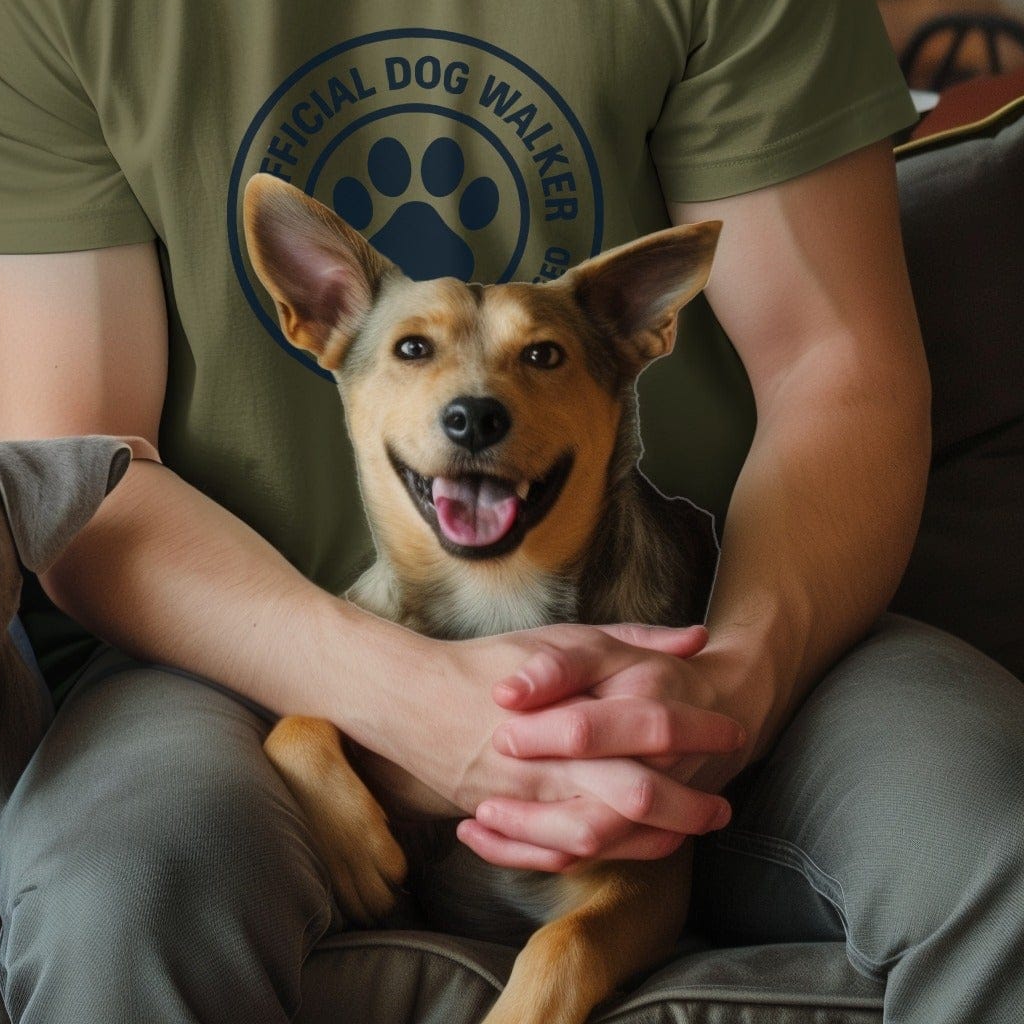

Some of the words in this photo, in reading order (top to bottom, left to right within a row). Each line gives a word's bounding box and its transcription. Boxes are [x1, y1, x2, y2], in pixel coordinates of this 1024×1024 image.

[259, 67, 377, 182] FFICIAL
[384, 55, 470, 95] DOG
[478, 74, 580, 223] WALKER
